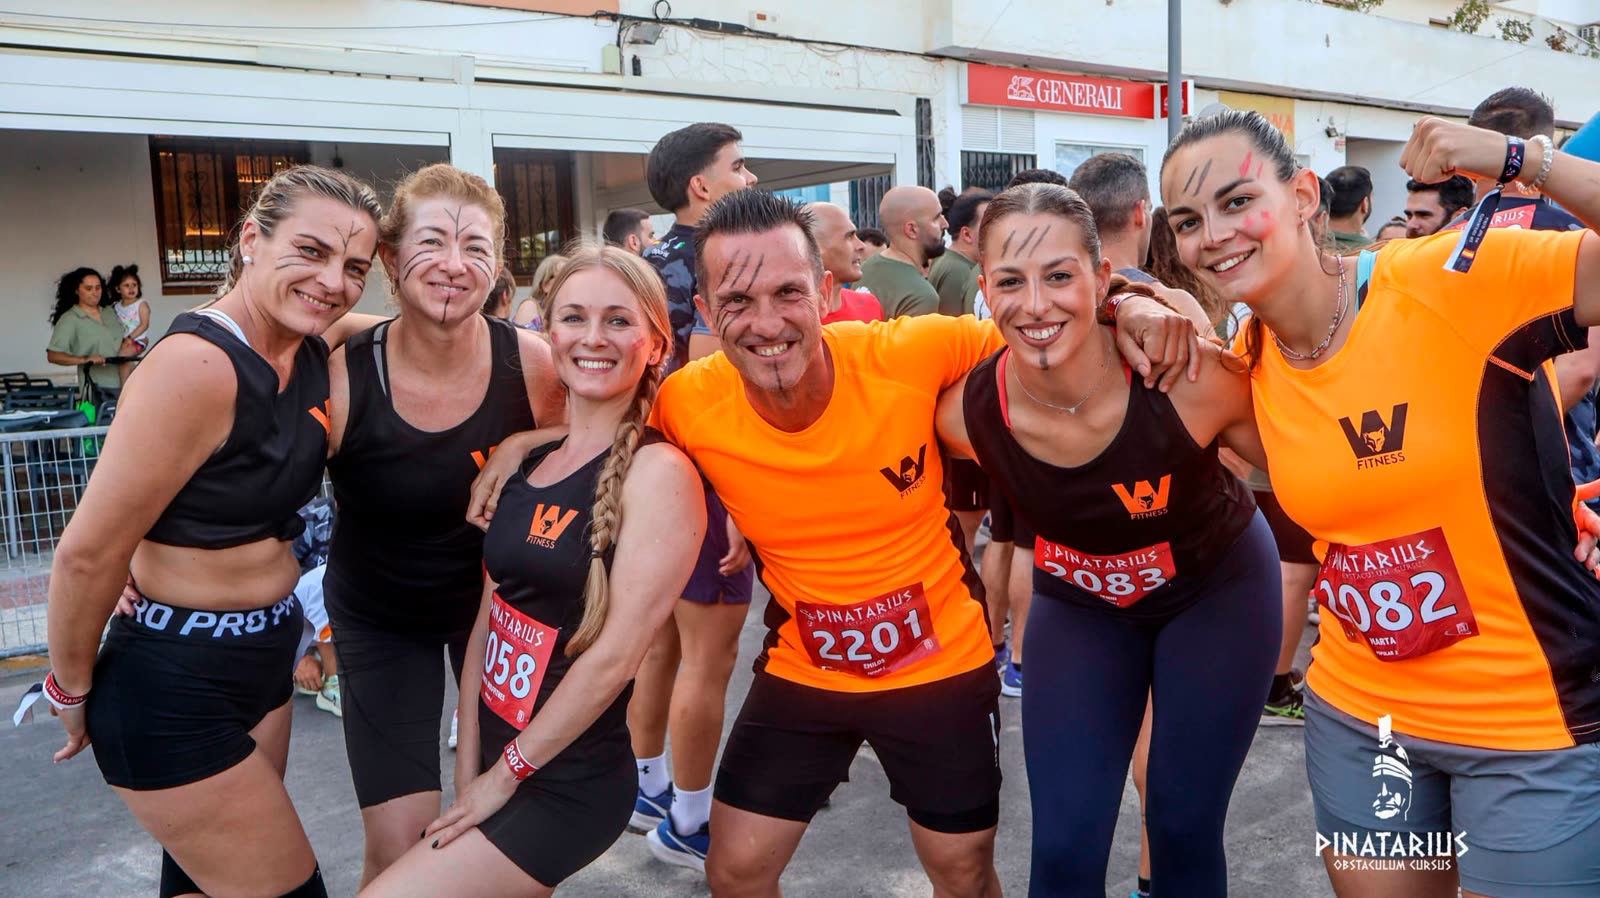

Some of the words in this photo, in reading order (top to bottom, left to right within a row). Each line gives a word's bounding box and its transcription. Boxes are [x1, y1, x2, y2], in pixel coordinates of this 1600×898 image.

[1036, 78, 1122, 110] GENERALI
[1338, 402, 1408, 459] W
[1357, 451, 1406, 470] FITNESS
[1111, 473, 1171, 514] W
[529, 503, 579, 541] W
[1130, 507, 1168, 521] FITNESS
[526, 535, 556, 549] FITNESS
[1055, 545, 1158, 569] PINATARIUS
[1044, 560, 1167, 596] 2083
[133, 598, 174, 631] RO
[179, 609, 268, 638] PRO
[816, 589, 912, 623] PINATARIUS
[1319, 570, 1458, 633] 2082
[812, 607, 923, 662] 2201
[485, 630, 537, 699] 058
[506, 744, 525, 772] 2058
